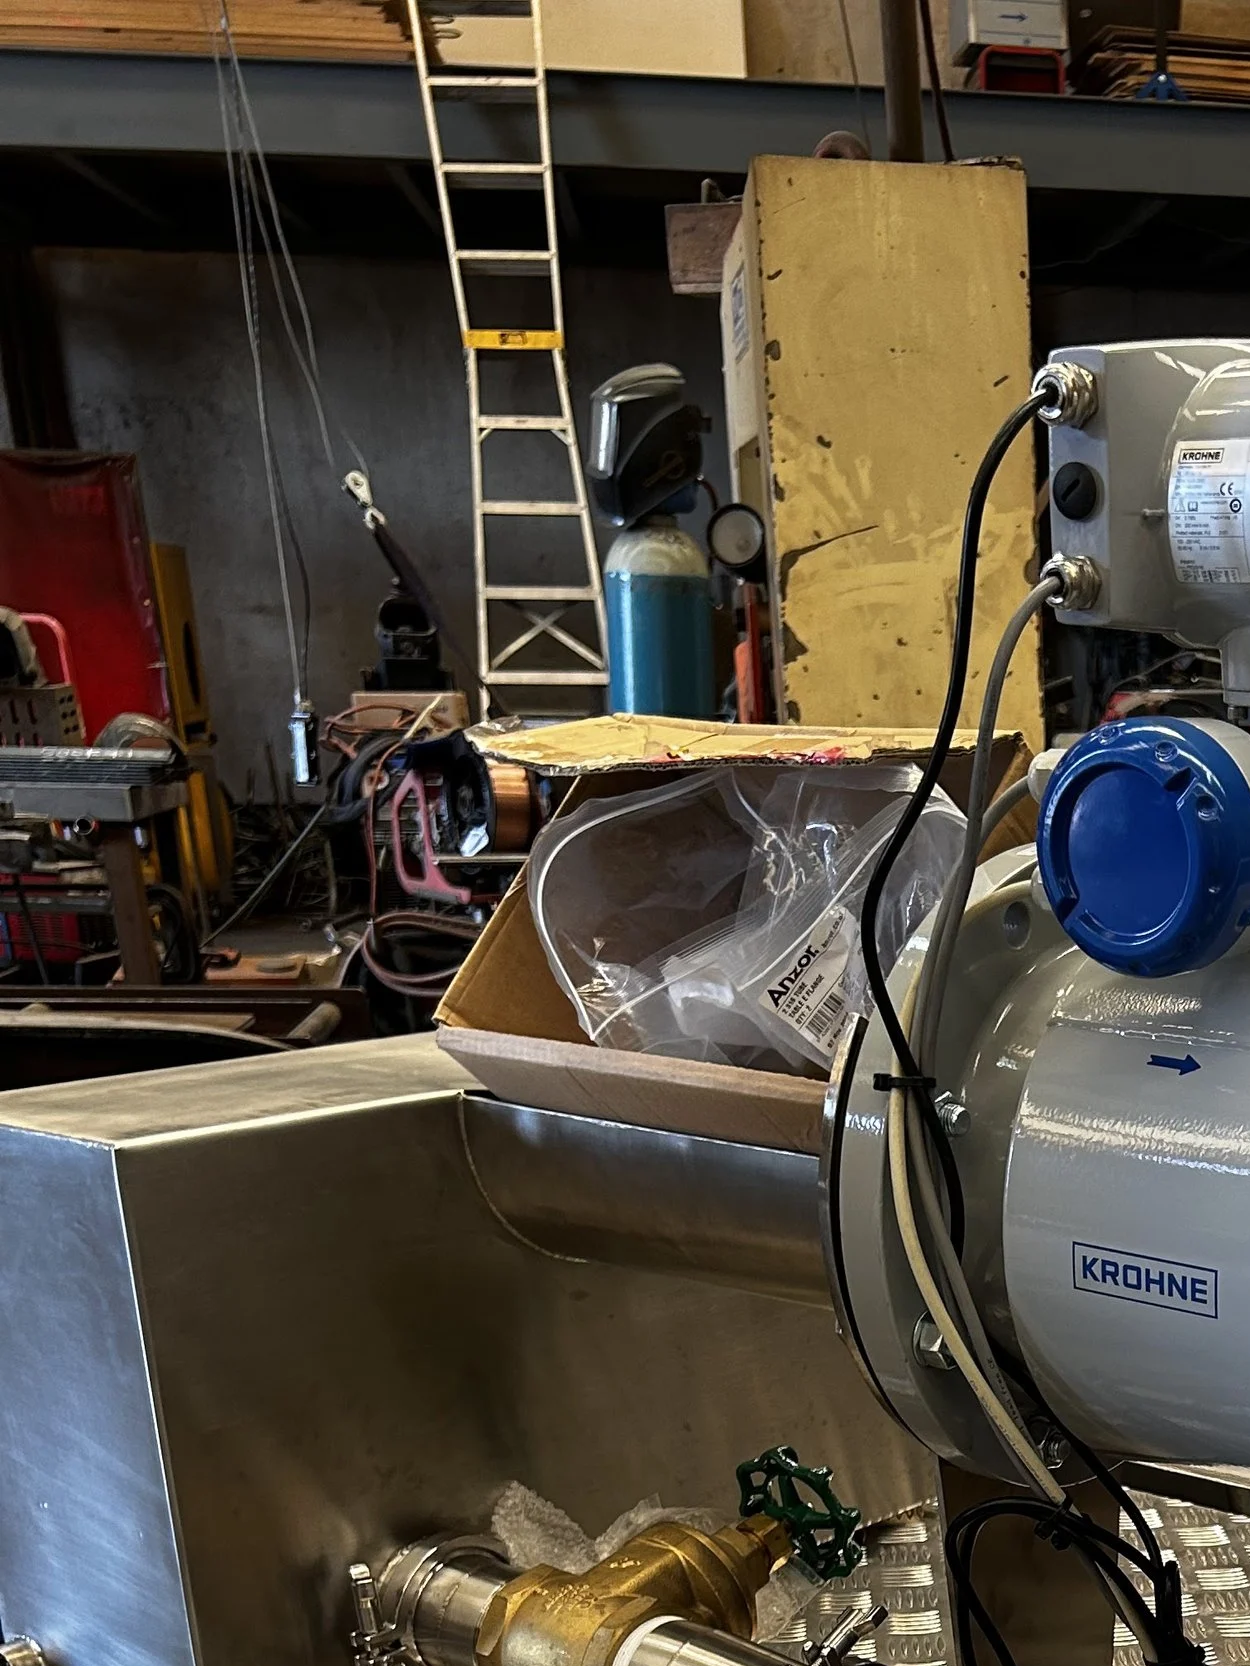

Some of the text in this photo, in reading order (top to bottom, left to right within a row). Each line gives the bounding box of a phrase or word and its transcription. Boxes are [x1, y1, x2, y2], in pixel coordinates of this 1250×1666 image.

[1181, 451, 1222, 461] KROHNE
[788, 1000, 806, 1019] TABLE
[806, 974, 825, 998] FLANGE
[793, 981, 809, 999] TUBE
[1081, 1255, 1208, 1305] KROHNE
